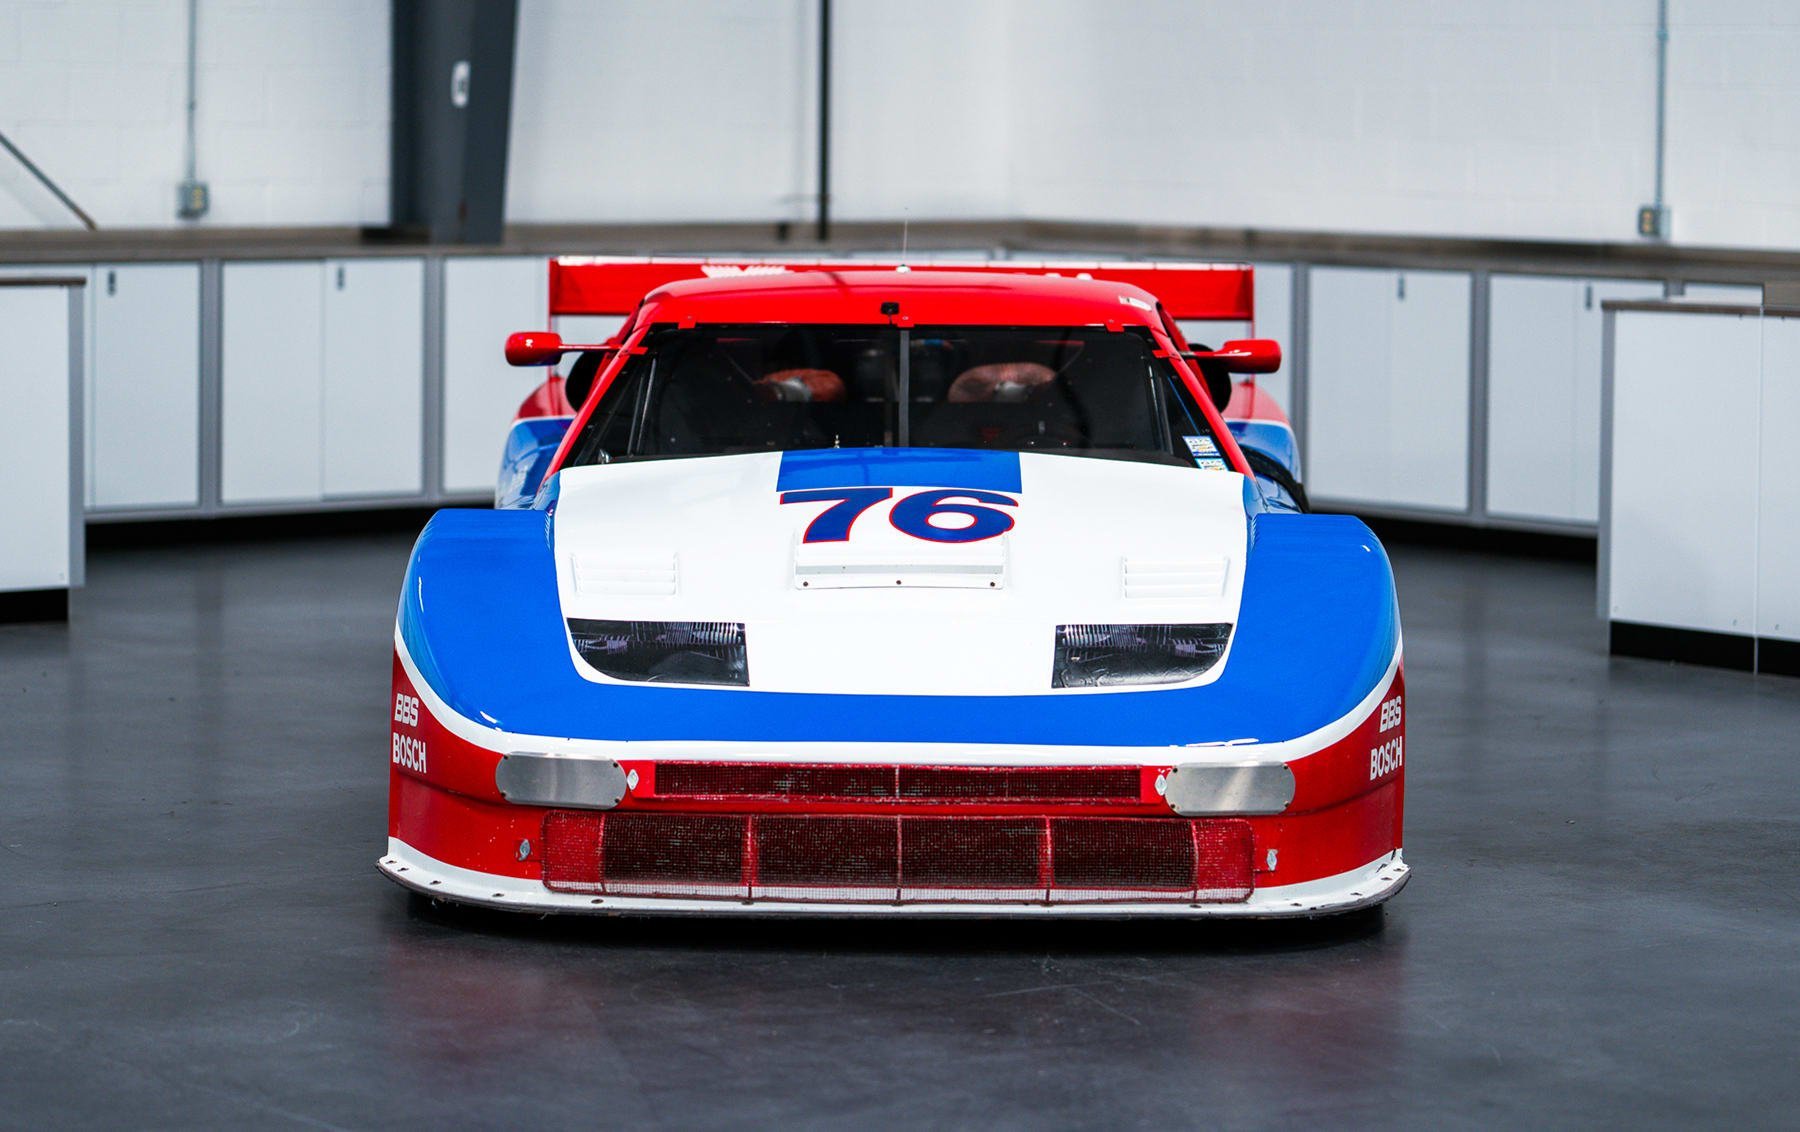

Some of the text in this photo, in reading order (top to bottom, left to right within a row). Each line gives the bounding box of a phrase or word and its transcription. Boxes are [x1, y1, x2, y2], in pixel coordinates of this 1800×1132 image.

[780, 487, 1019, 544] 76
[394, 692, 419, 727] BBS
[1379, 695, 1402, 733] BBS
[392, 732, 427, 774] BOSCH
[1370, 735, 1403, 781] BOSCH
